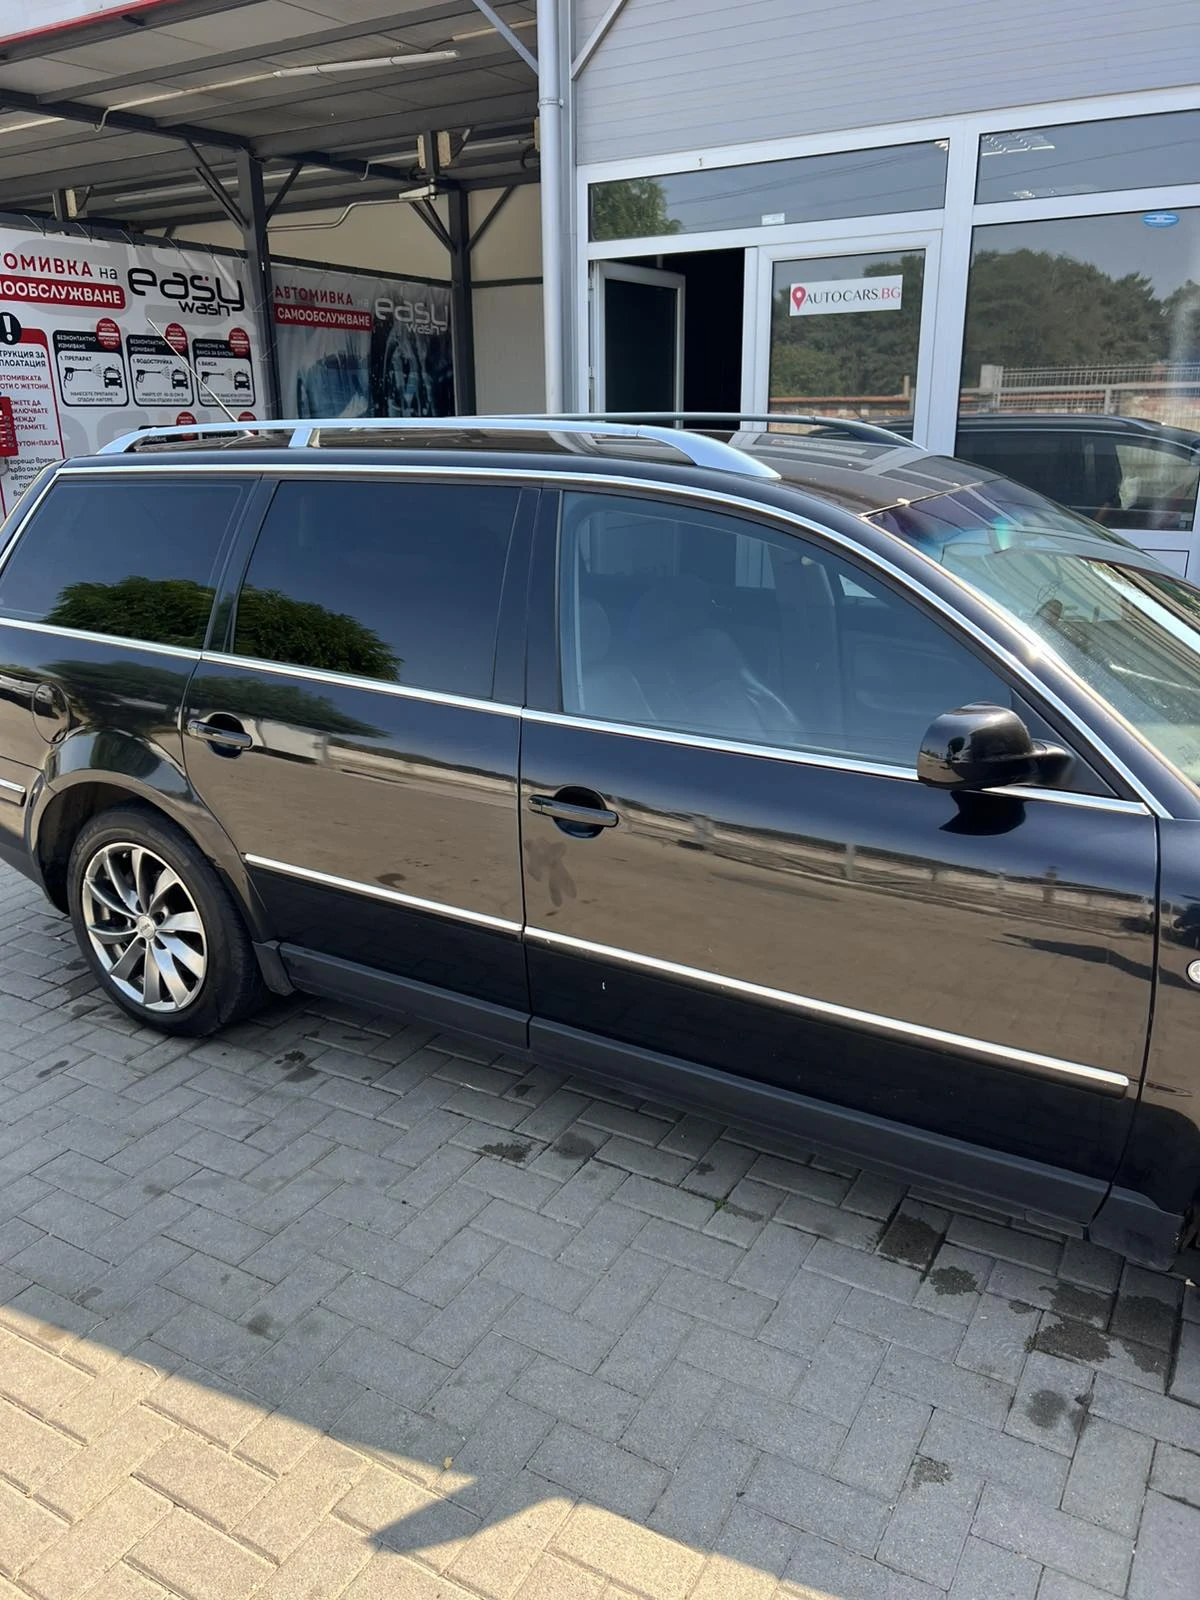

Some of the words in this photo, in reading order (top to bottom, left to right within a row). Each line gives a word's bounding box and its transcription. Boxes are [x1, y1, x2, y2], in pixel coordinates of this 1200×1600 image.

[0, 252, 93, 277] ОМИВКА
[99, 267, 118, 280] на
[127, 267, 245, 311] easy
[274, 285, 353, 306] АВТОМИВКА
[806, 286, 901, 305] AUTOCARS.BG
[178, 300, 230, 316] wash
[277, 307, 370, 327] САМООБСЛУЖВАНЕ
[374, 298, 449, 331] easy
[406, 322, 440, 336] wash
[36, 351, 45, 359] ЗА
